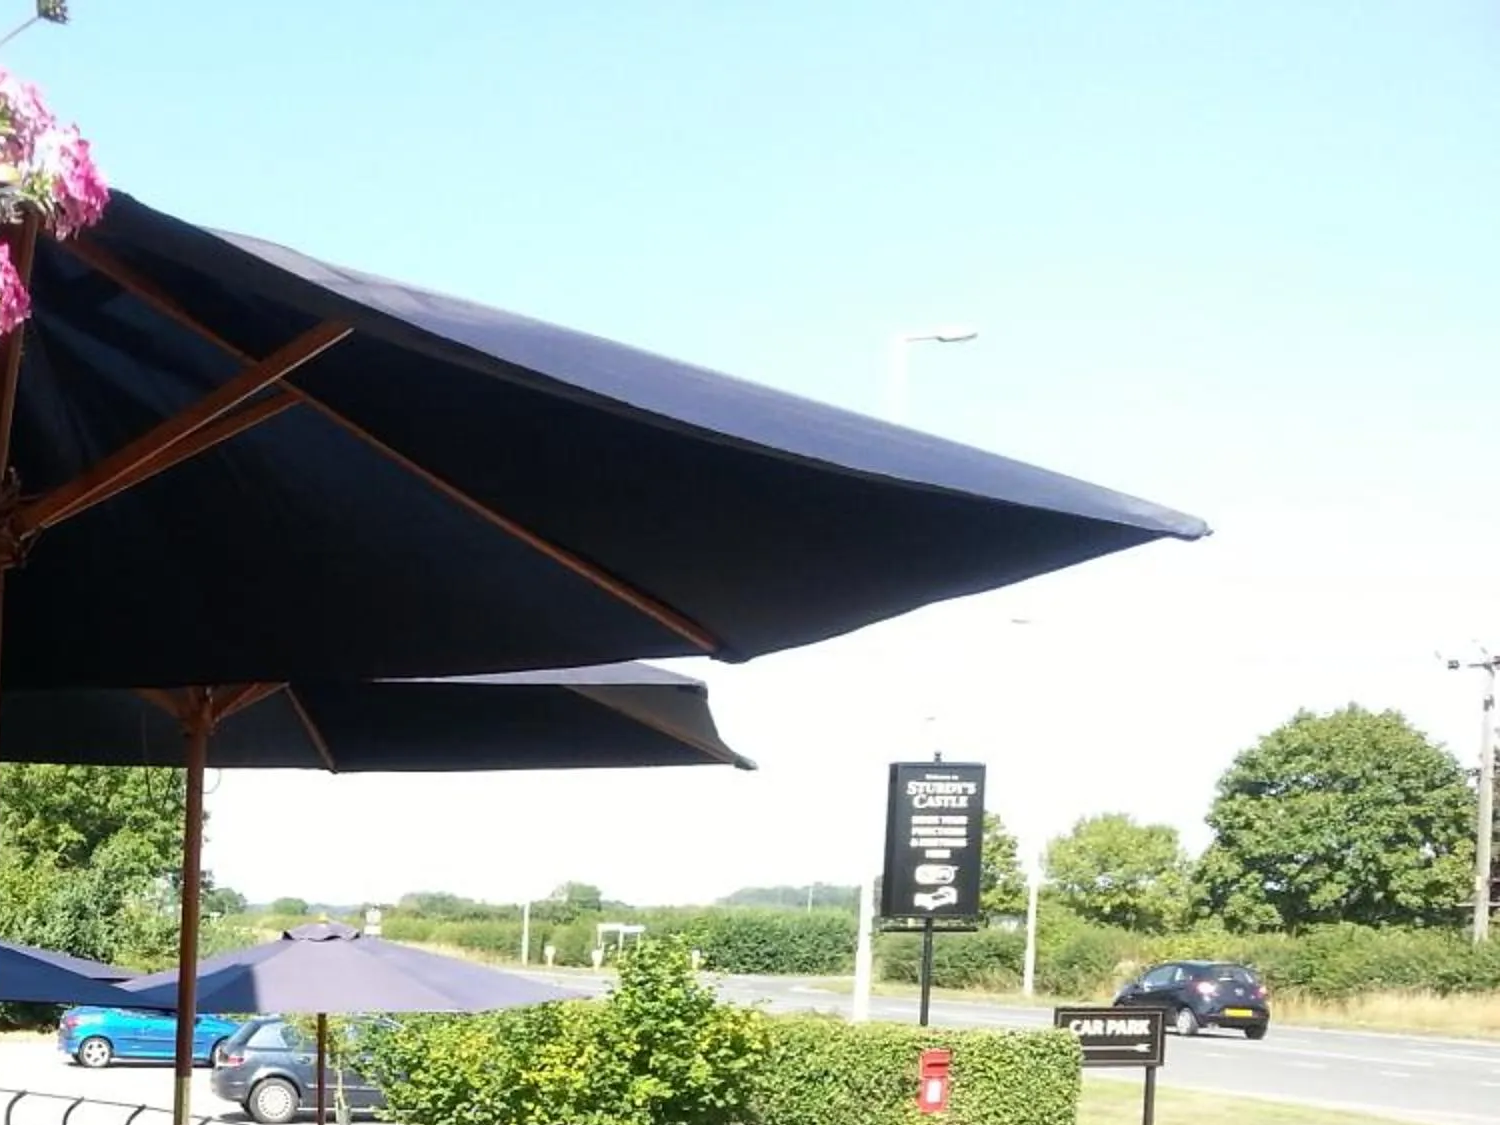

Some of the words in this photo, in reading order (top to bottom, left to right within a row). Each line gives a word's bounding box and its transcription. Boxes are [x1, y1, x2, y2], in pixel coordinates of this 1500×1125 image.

[913, 794, 968, 808] CASTLE
[1069, 1019, 1104, 1035] CAR
[1106, 1019, 1151, 1035] PARK
